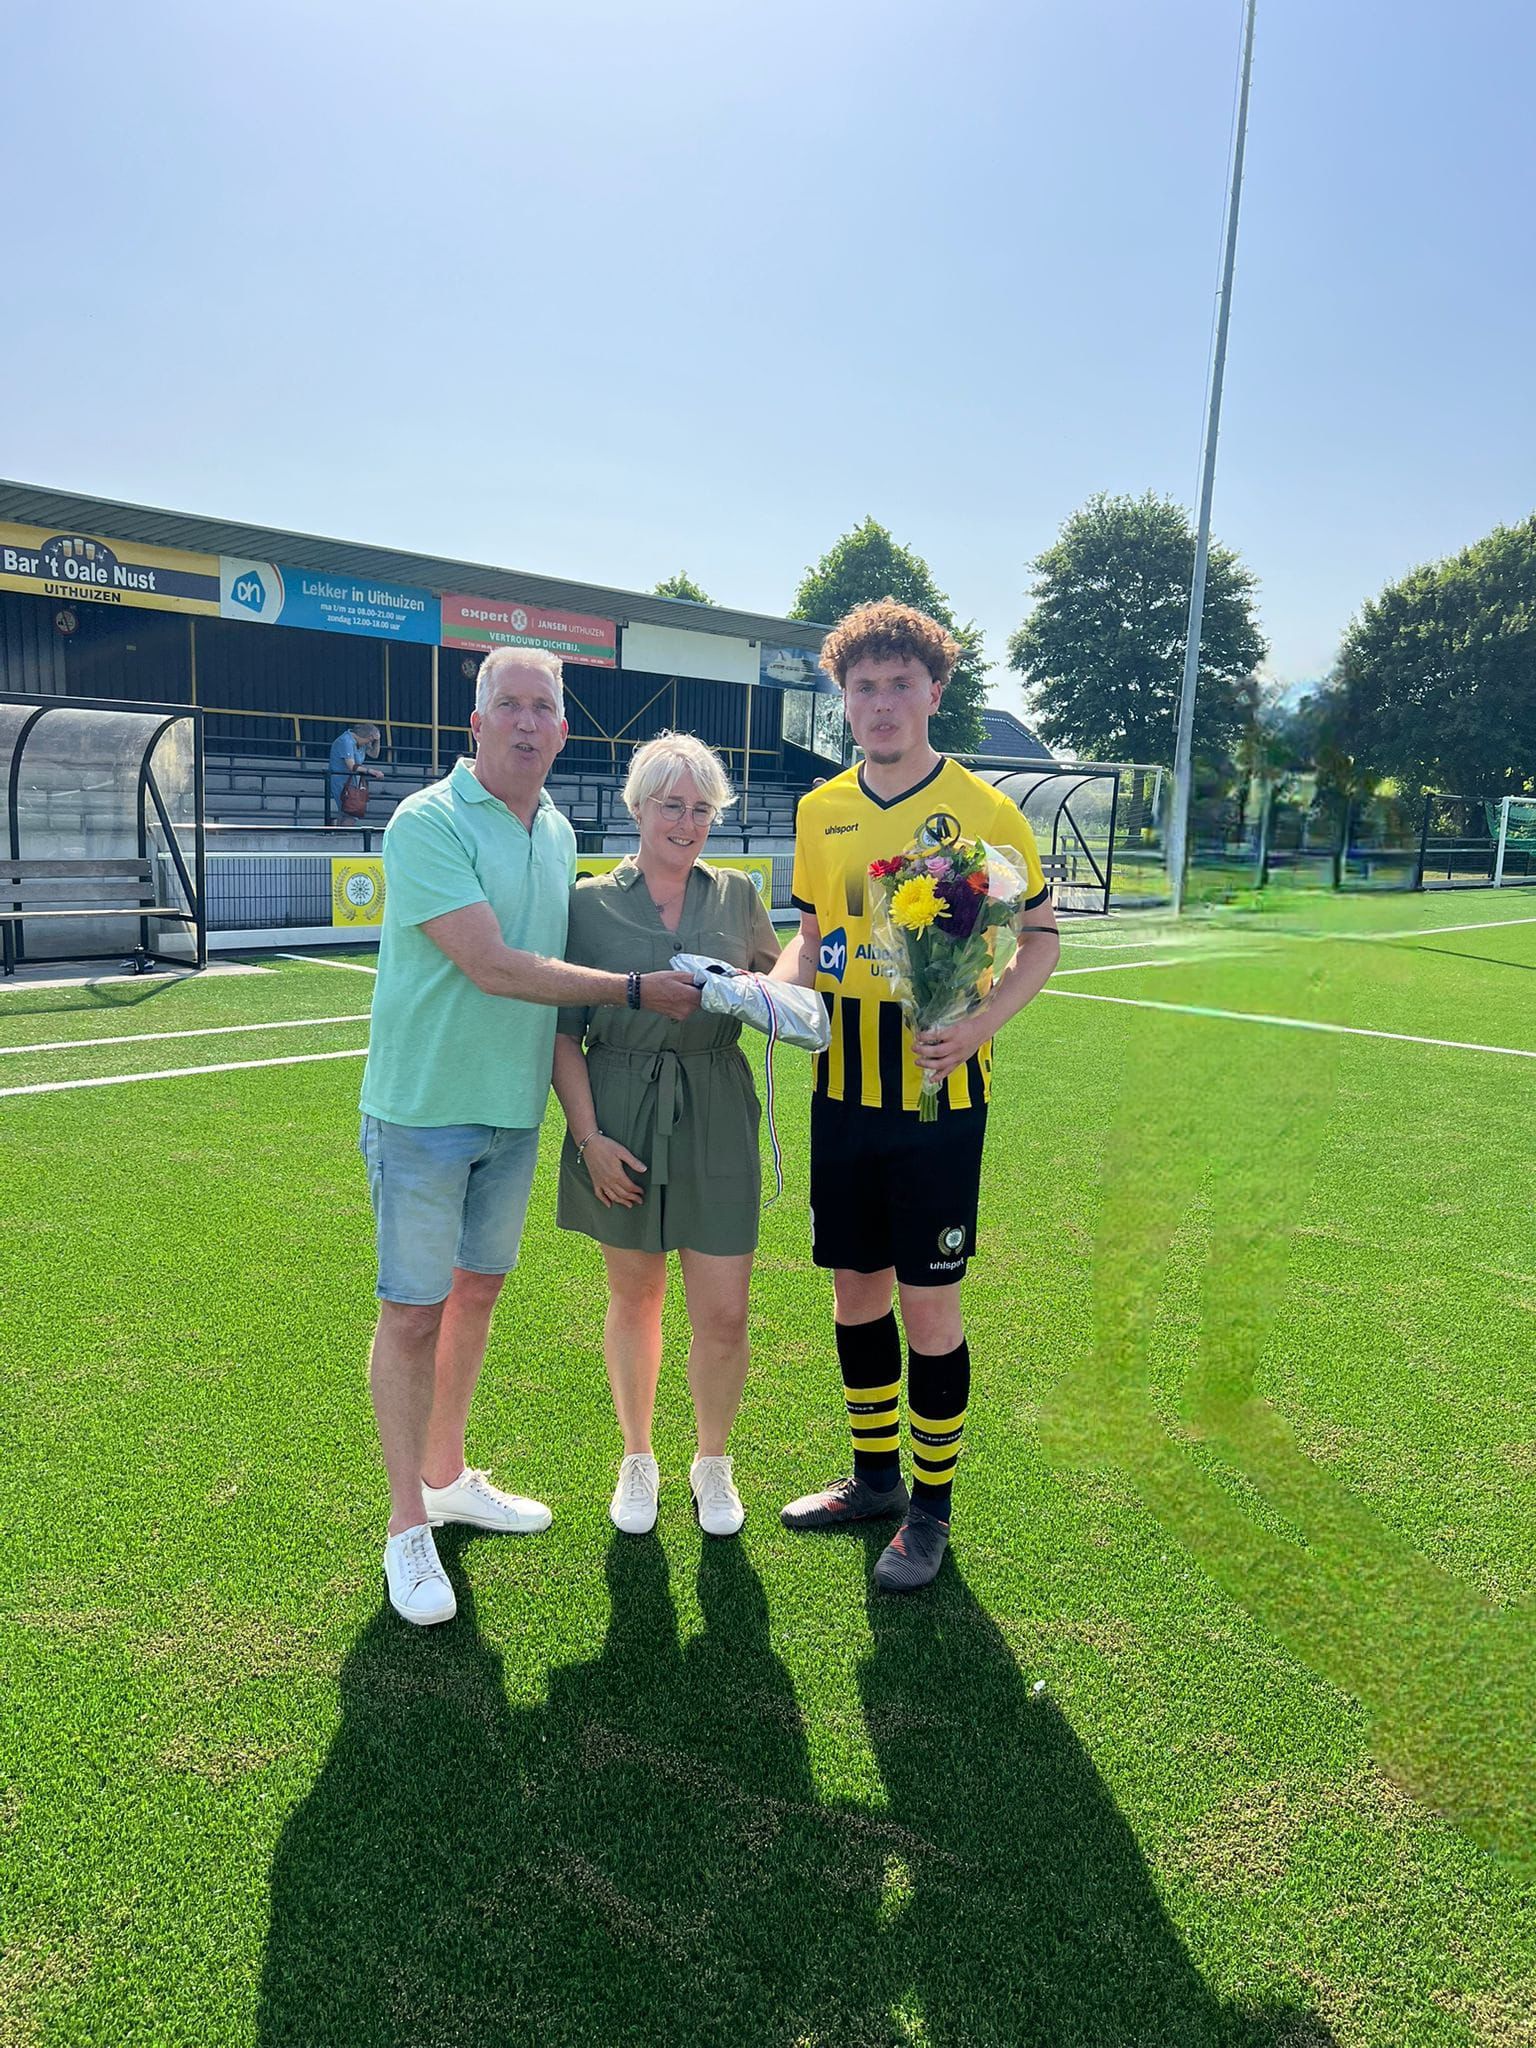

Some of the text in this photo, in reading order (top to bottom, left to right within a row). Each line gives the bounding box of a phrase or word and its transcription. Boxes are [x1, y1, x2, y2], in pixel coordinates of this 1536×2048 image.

[4, 549, 156, 590] Bar 't Oale Nust
[44, 583, 121, 603] UITHUIZEN
[302, 580, 425, 612] Lekker in Uithuizen
[327, 614, 352, 625] zondag
[461, 607, 509, 624] expert
[537, 619, 605, 638] JANSEN UITHUIZEN
[489, 631, 541, 647] VERTROUWD
[824, 822, 859, 836] uhlsport
